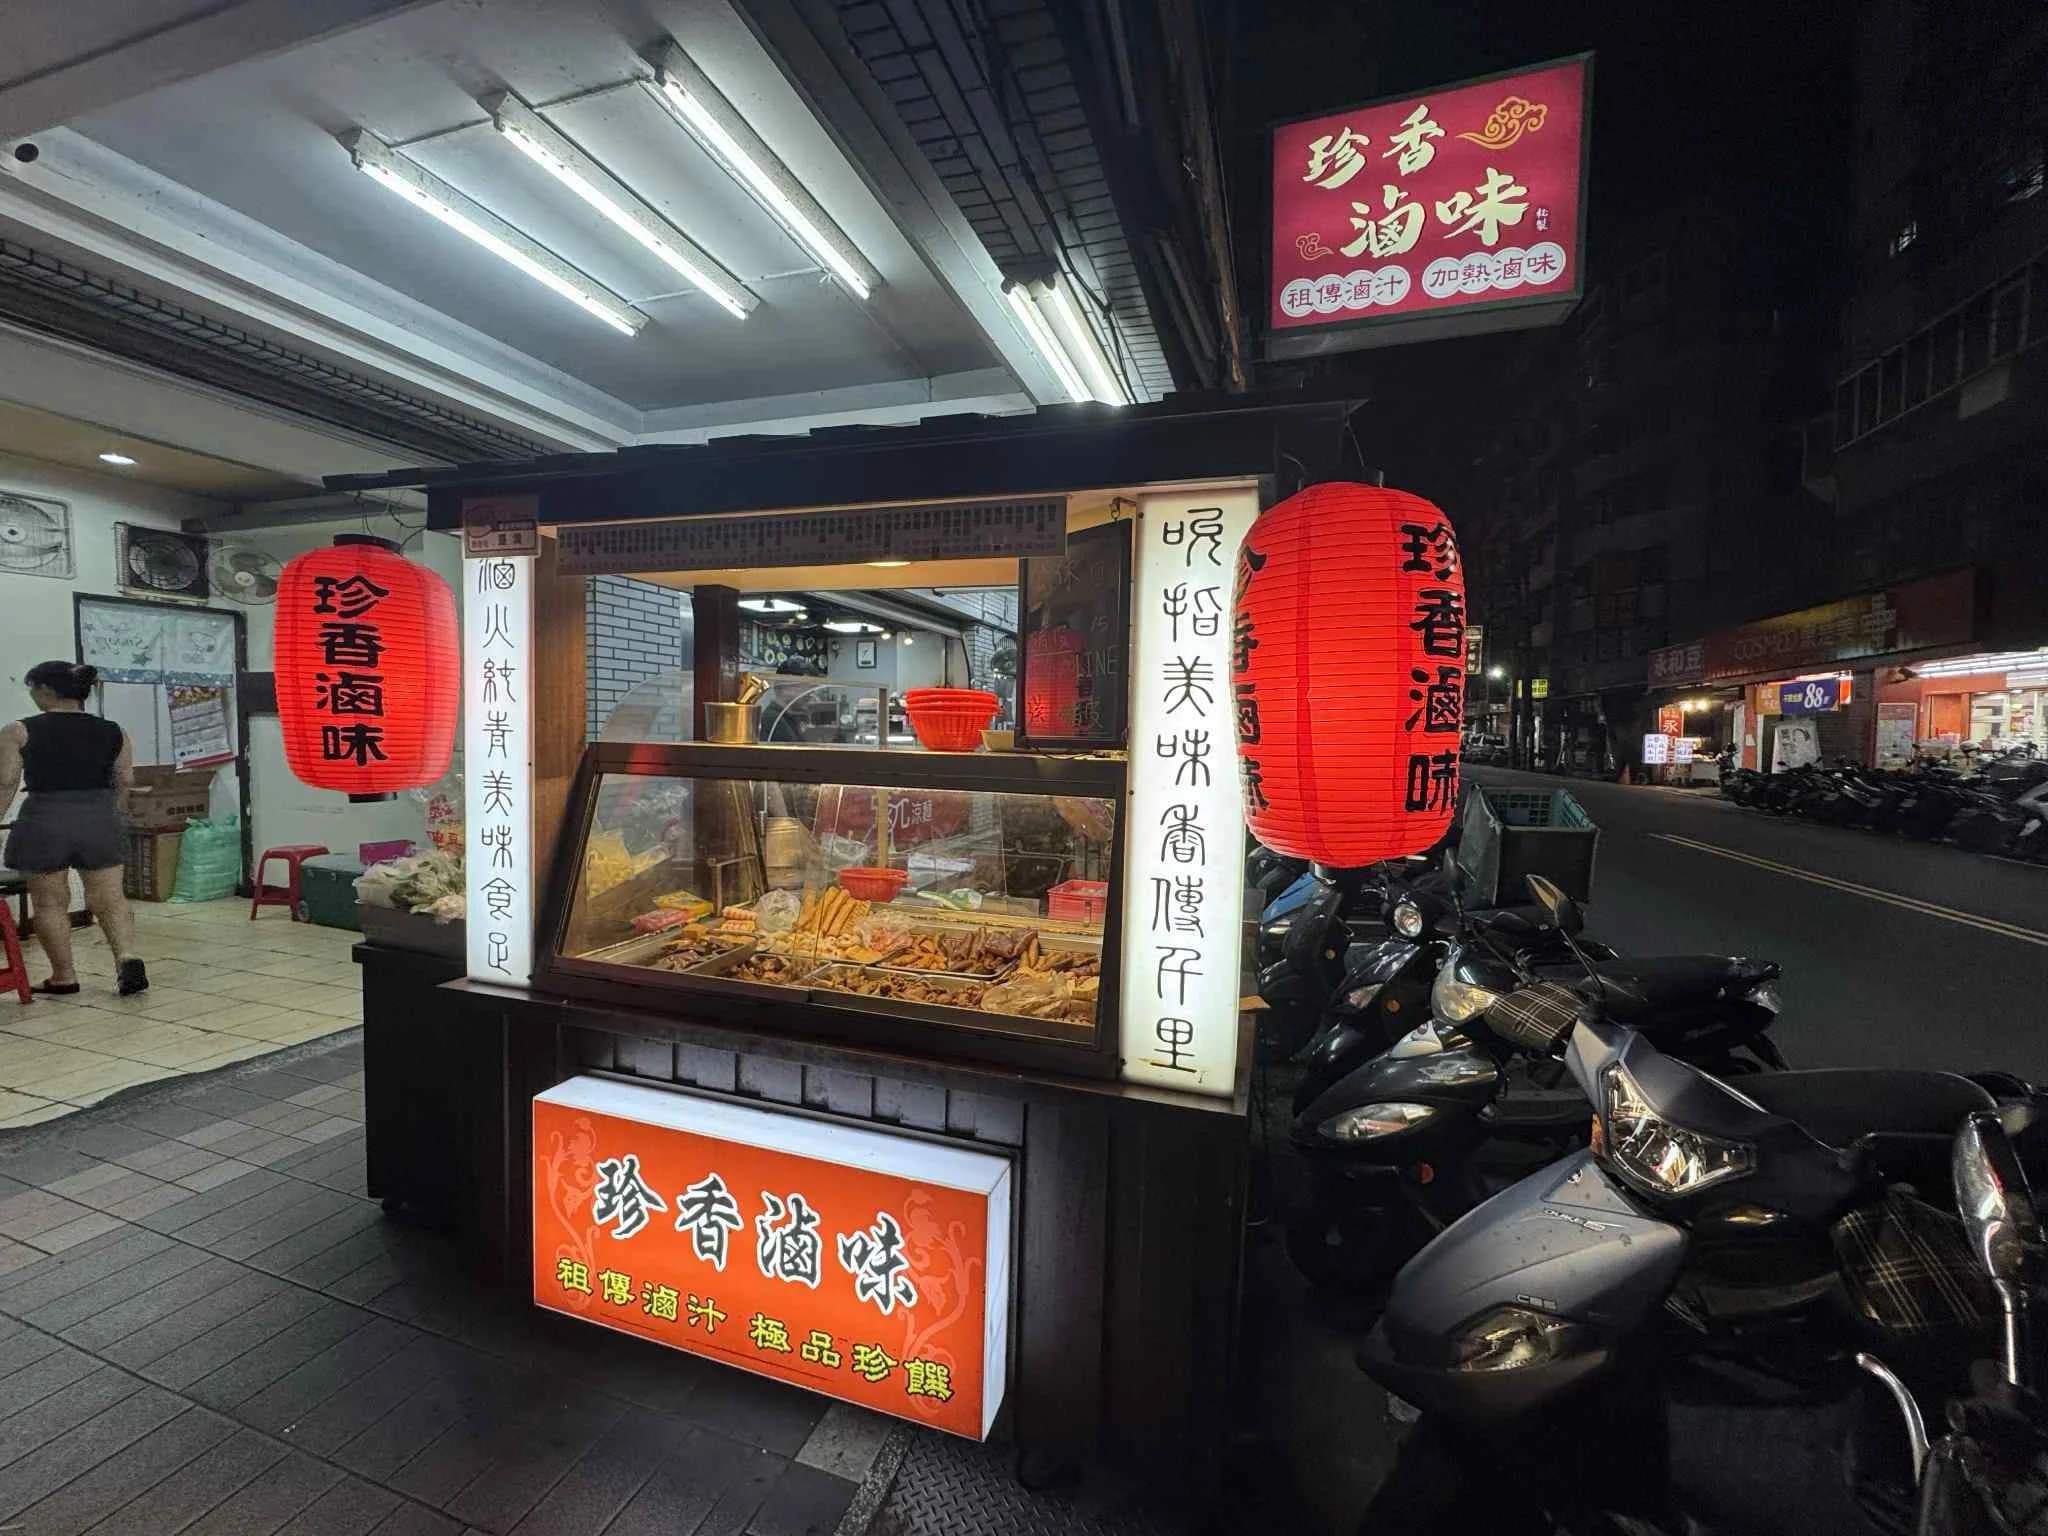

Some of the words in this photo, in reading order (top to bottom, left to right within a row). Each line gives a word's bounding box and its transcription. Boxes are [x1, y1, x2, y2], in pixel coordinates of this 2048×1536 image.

[1303, 104, 1445, 189] 珍香
[1340, 167, 1531, 258] 滷味
[1429, 252, 1558, 288] 加熱滷味
[1287, 274, 1403, 310] 祖傳滷汁
[313, 574, 390, 767] 珍香滷味
[1401, 522, 1466, 817] 珍香滷味
[593, 1154, 918, 1316] 珍香滷味
[556, 1257, 726, 1333] 祖傳滷汁
[748, 1313, 954, 1401] 極品珍饌
